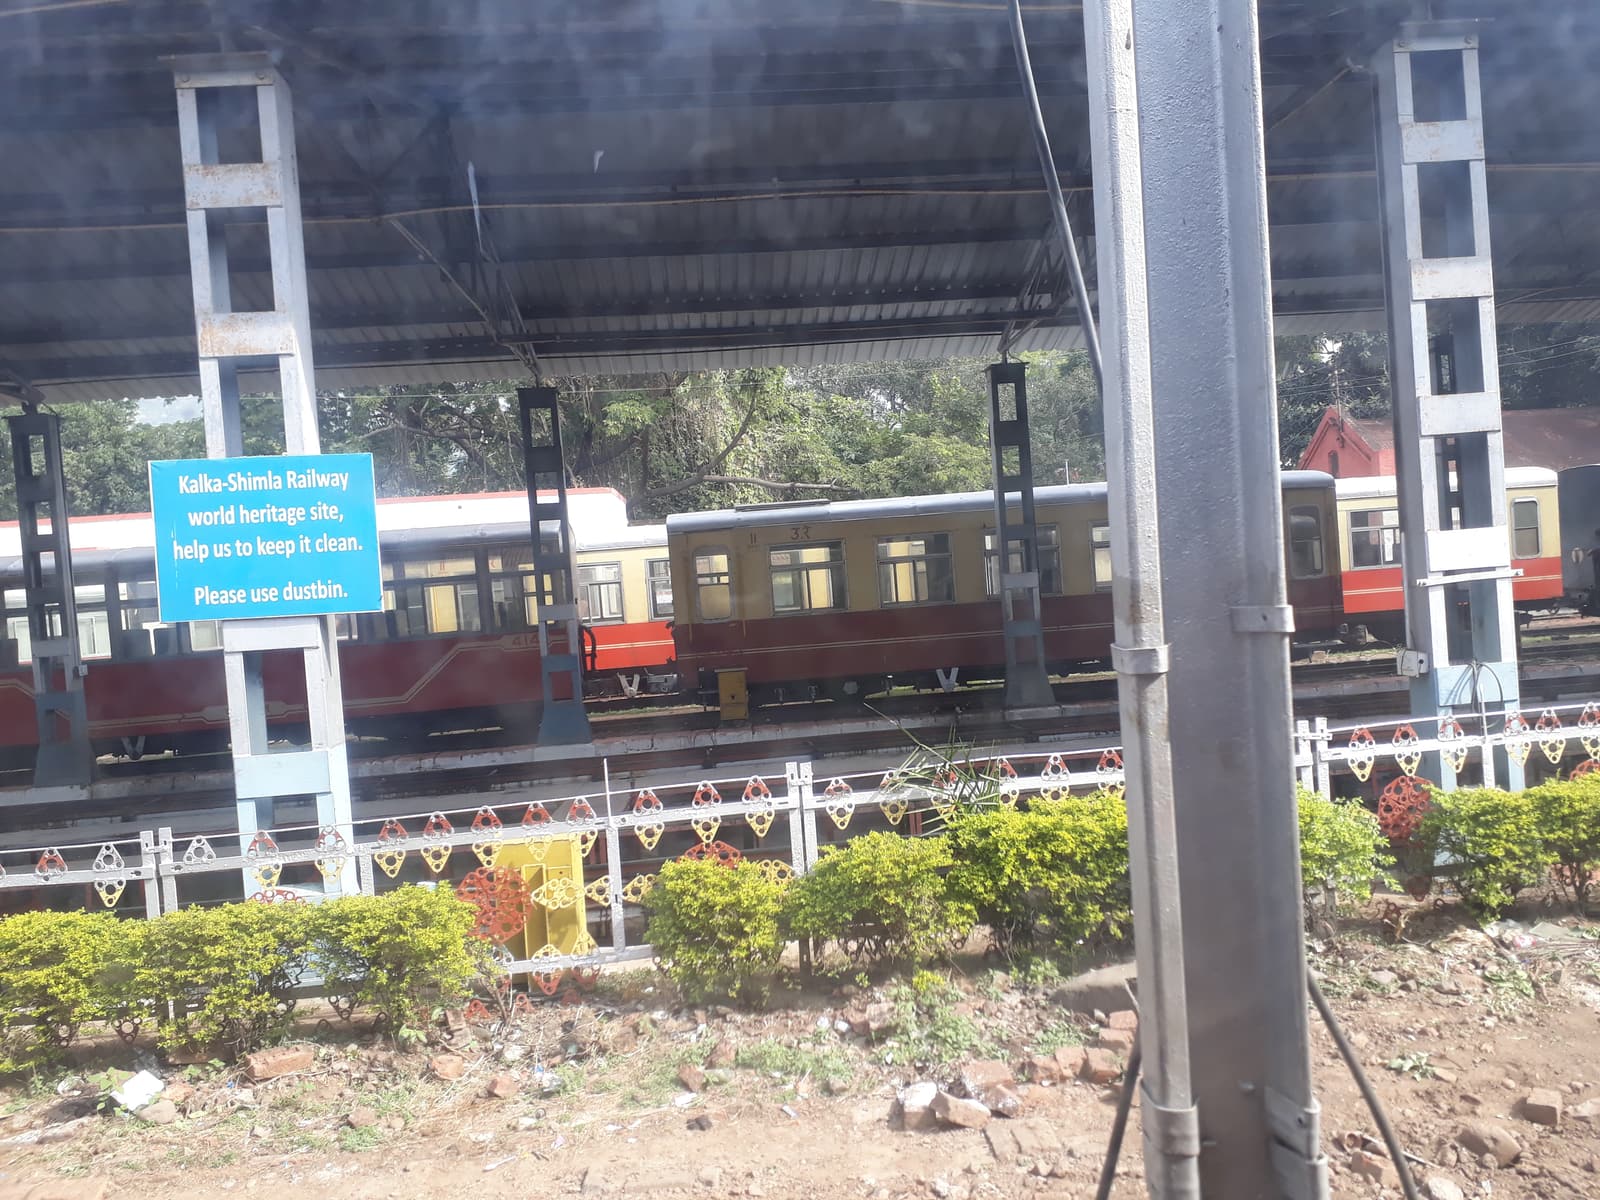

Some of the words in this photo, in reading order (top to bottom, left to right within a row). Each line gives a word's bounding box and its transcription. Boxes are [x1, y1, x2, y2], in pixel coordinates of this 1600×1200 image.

[178, 470, 282, 494] Kalka-Shimla
[286, 469, 349, 491] Railway
[188, 504, 235, 526] world
[239, 503, 306, 526] heritage
[310, 501, 344, 523] site,
[173, 539, 209, 563] help
[213, 543, 231, 558] us
[235, 540, 253, 557] to
[257, 536, 296, 558] keep
[299, 535, 311, 553] it
[315, 533, 363, 553] clean.
[194, 586, 247, 605] Please
[250, 588, 279, 602] use
[282, 580, 348, 602] dustbin.
